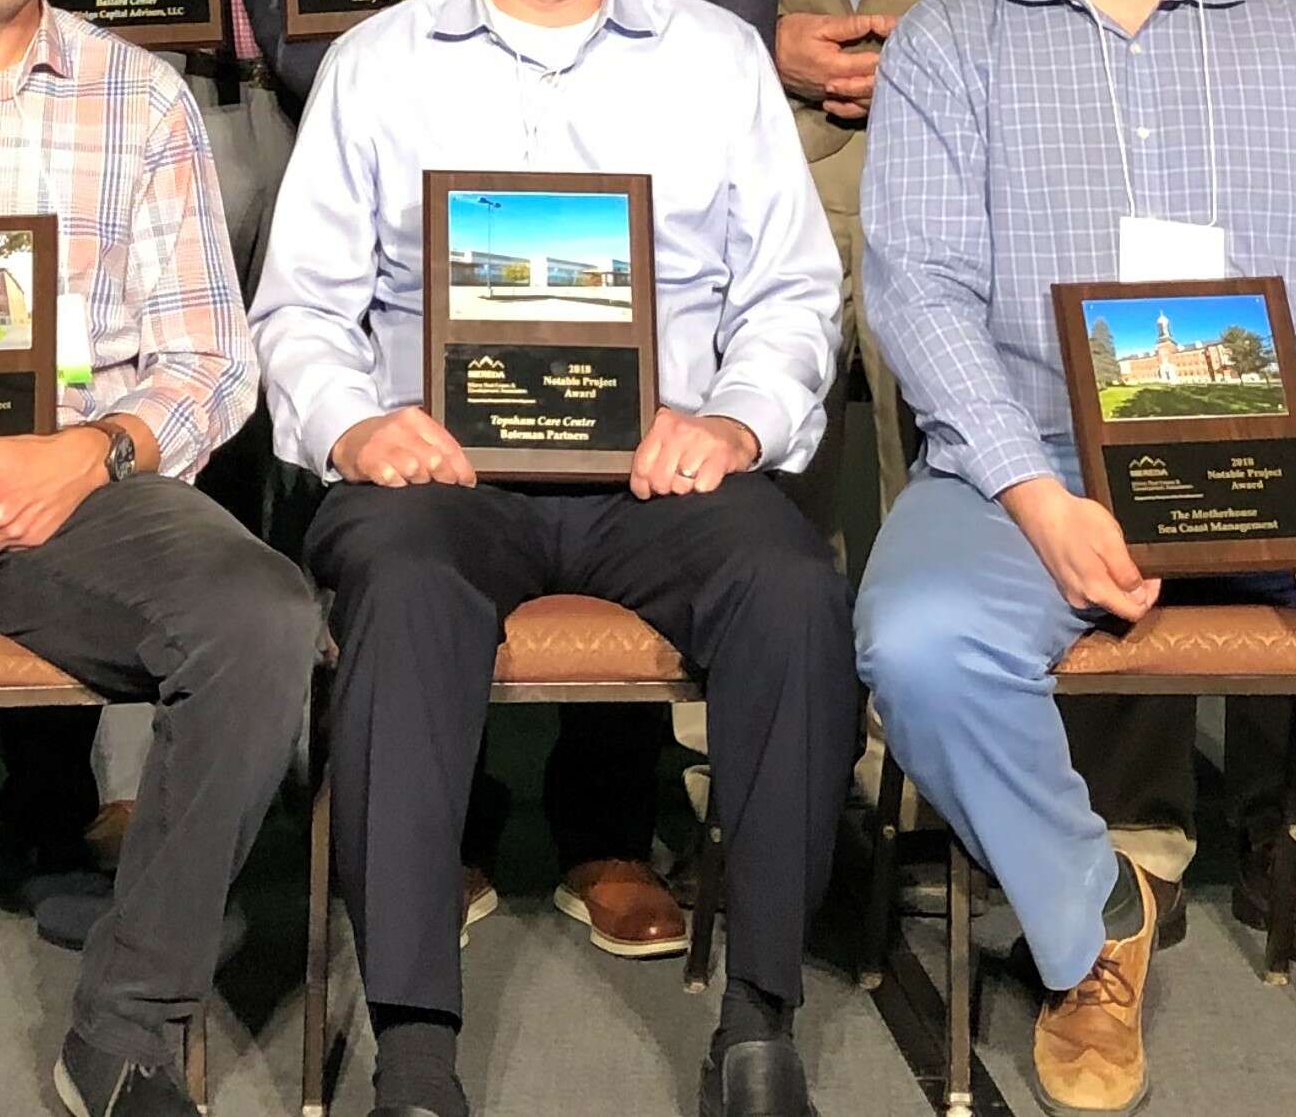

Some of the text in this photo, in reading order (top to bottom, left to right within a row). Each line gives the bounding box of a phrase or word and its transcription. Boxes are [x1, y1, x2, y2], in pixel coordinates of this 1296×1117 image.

[99, 9, 128, 21] Capital
[167, 6, 185, 16] LLC
[567, 364, 592, 375] 2018
[543, 375, 618, 388] Notable Project
[564, 388, 596, 399] Award
[490, 415, 596, 428] Topsham Care Center
[546, 430, 589, 441] Partners
[1230, 457, 1255, 468] 2018
[1207, 468, 1283, 480] Notable Project
[1231, 480, 1264, 491] Award
[1170, 507, 1258, 521] The Motherhouse
[1157, 519, 1279, 535] Sea Coast Management
